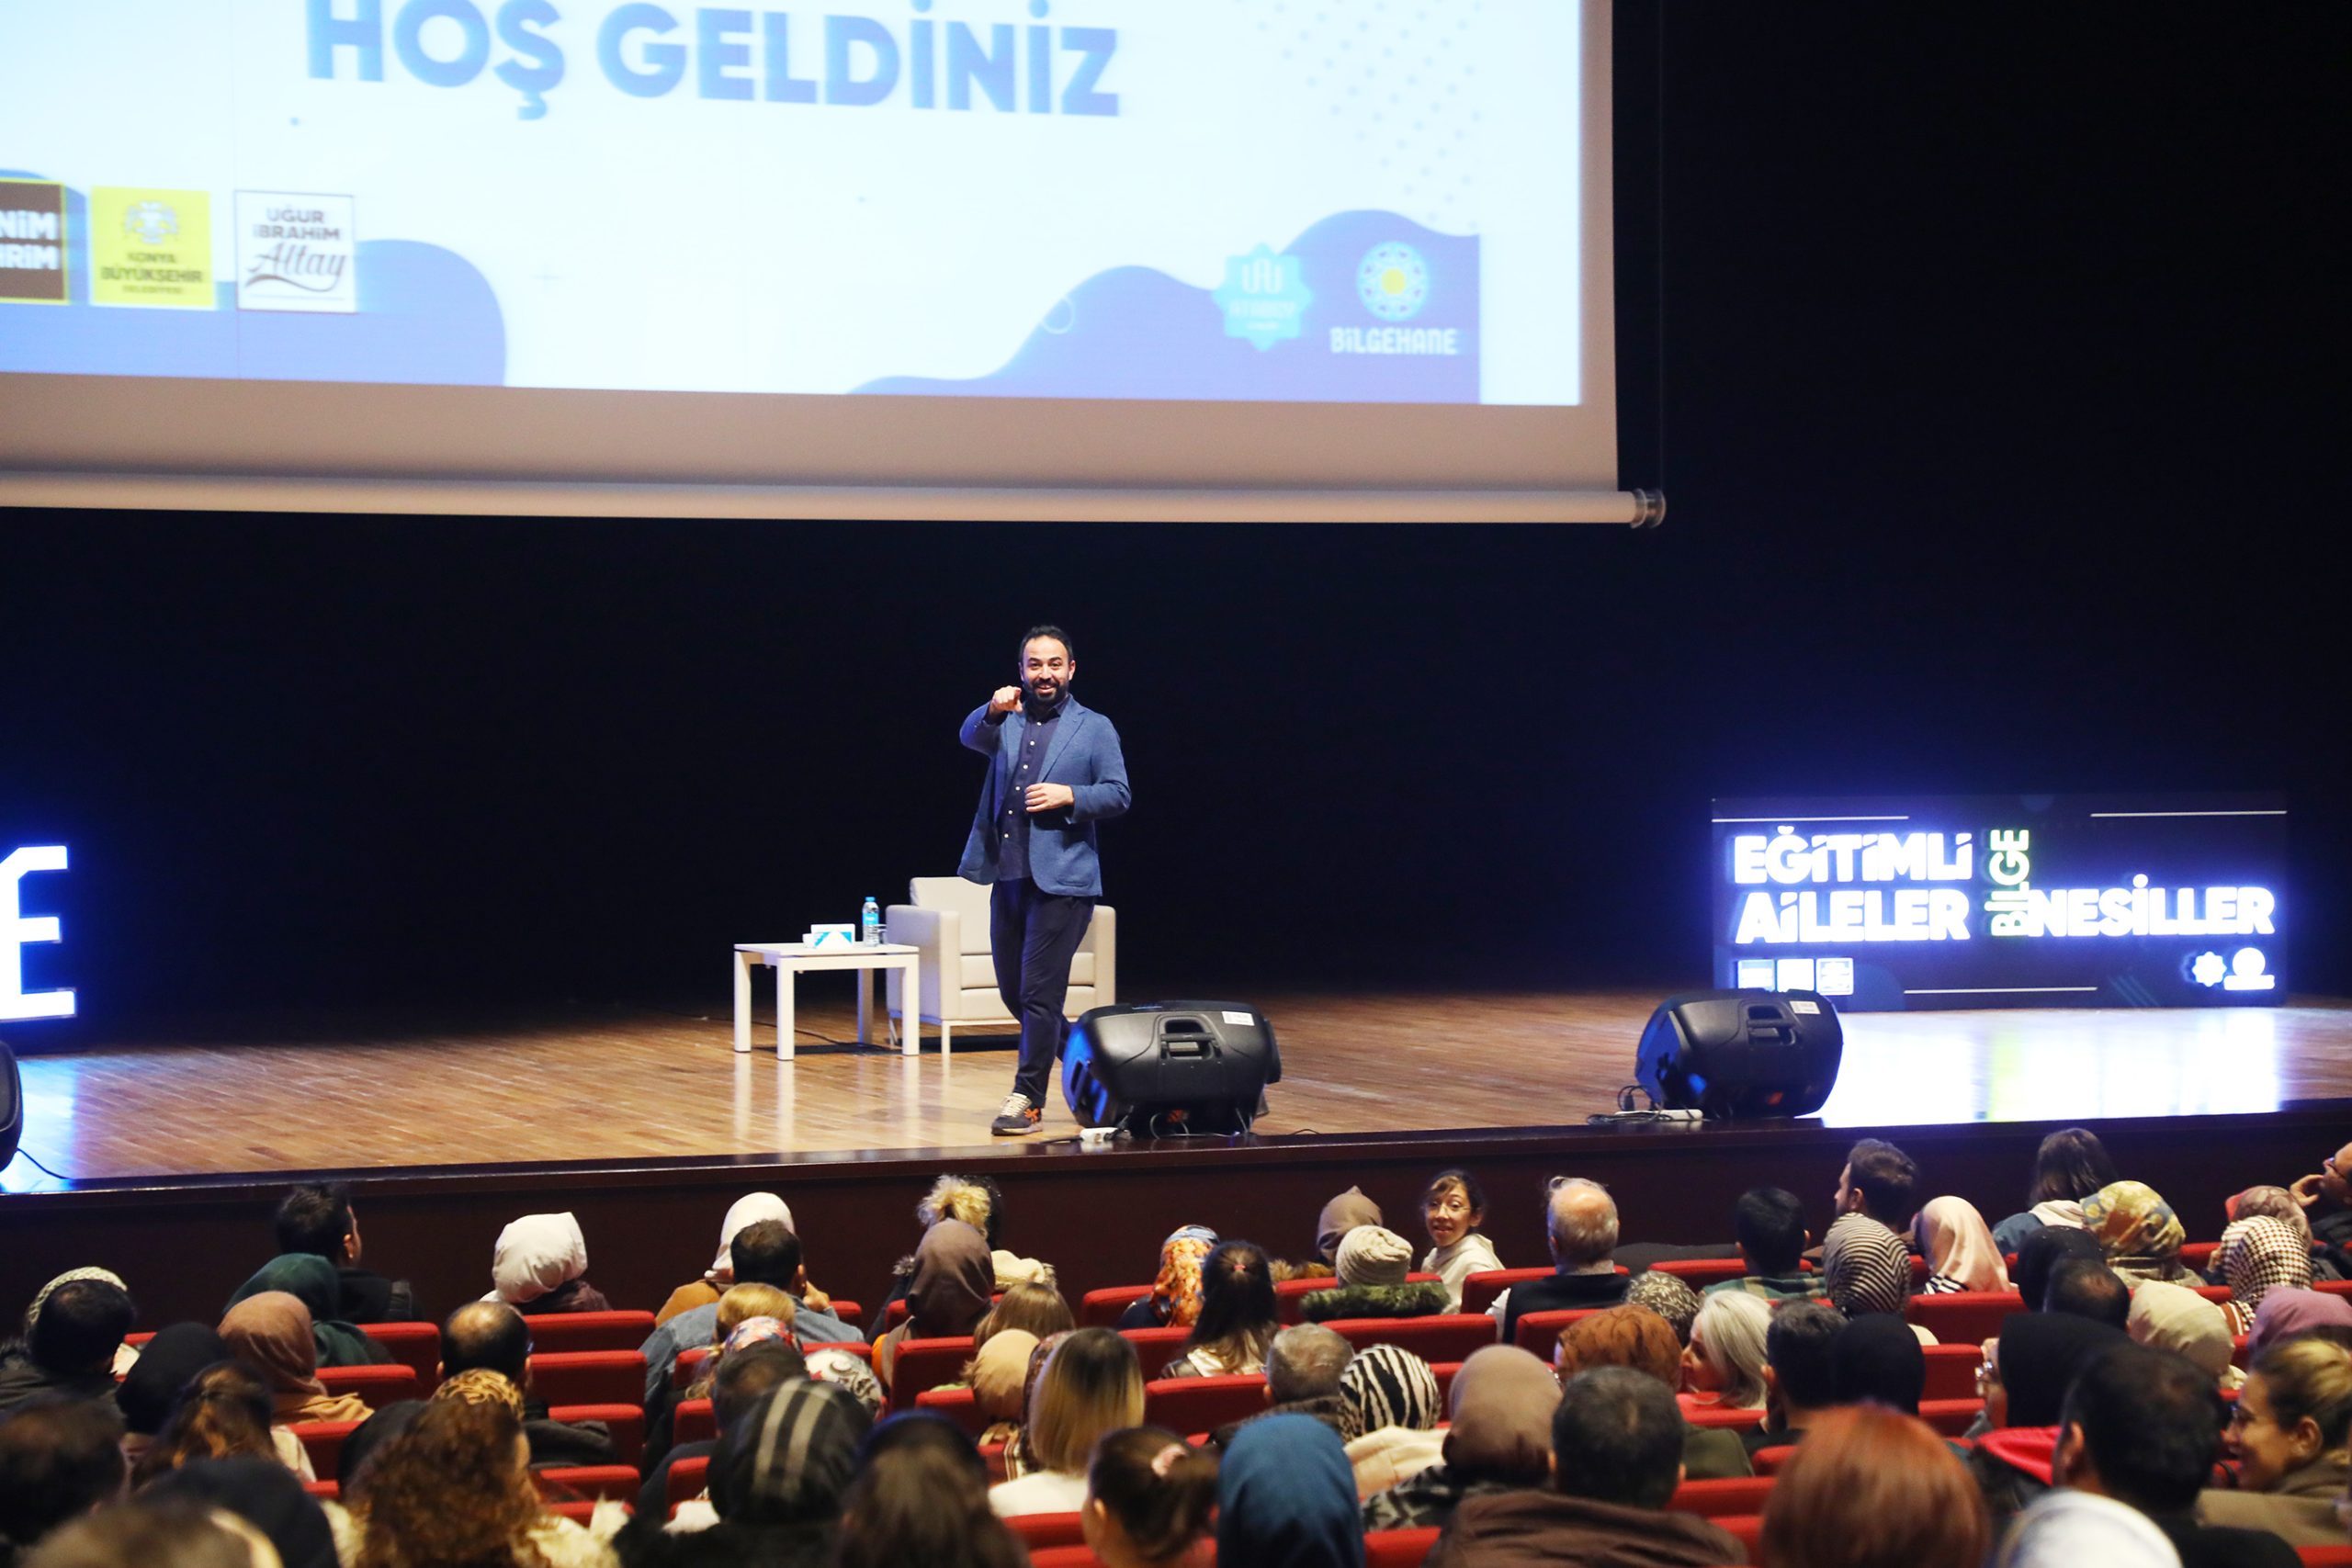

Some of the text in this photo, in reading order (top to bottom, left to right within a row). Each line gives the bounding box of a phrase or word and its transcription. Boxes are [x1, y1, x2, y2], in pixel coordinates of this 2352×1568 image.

[306, 0, 1119, 119] HOŞ GELDİNİZ
[253, 224, 341, 241] İBRAHİM
[266, 204, 324, 223] UĞUR
[246, 243, 347, 292] Altay
[1329, 326, 1457, 355] BİLGEHANE
[1734, 826, 1973, 884] EĞİTİMLİ
[1984, 829, 2030, 937] BİLGE
[2028, 874, 2276, 937] NESİLLER
[1735, 890, 1971, 943] AİLELER
